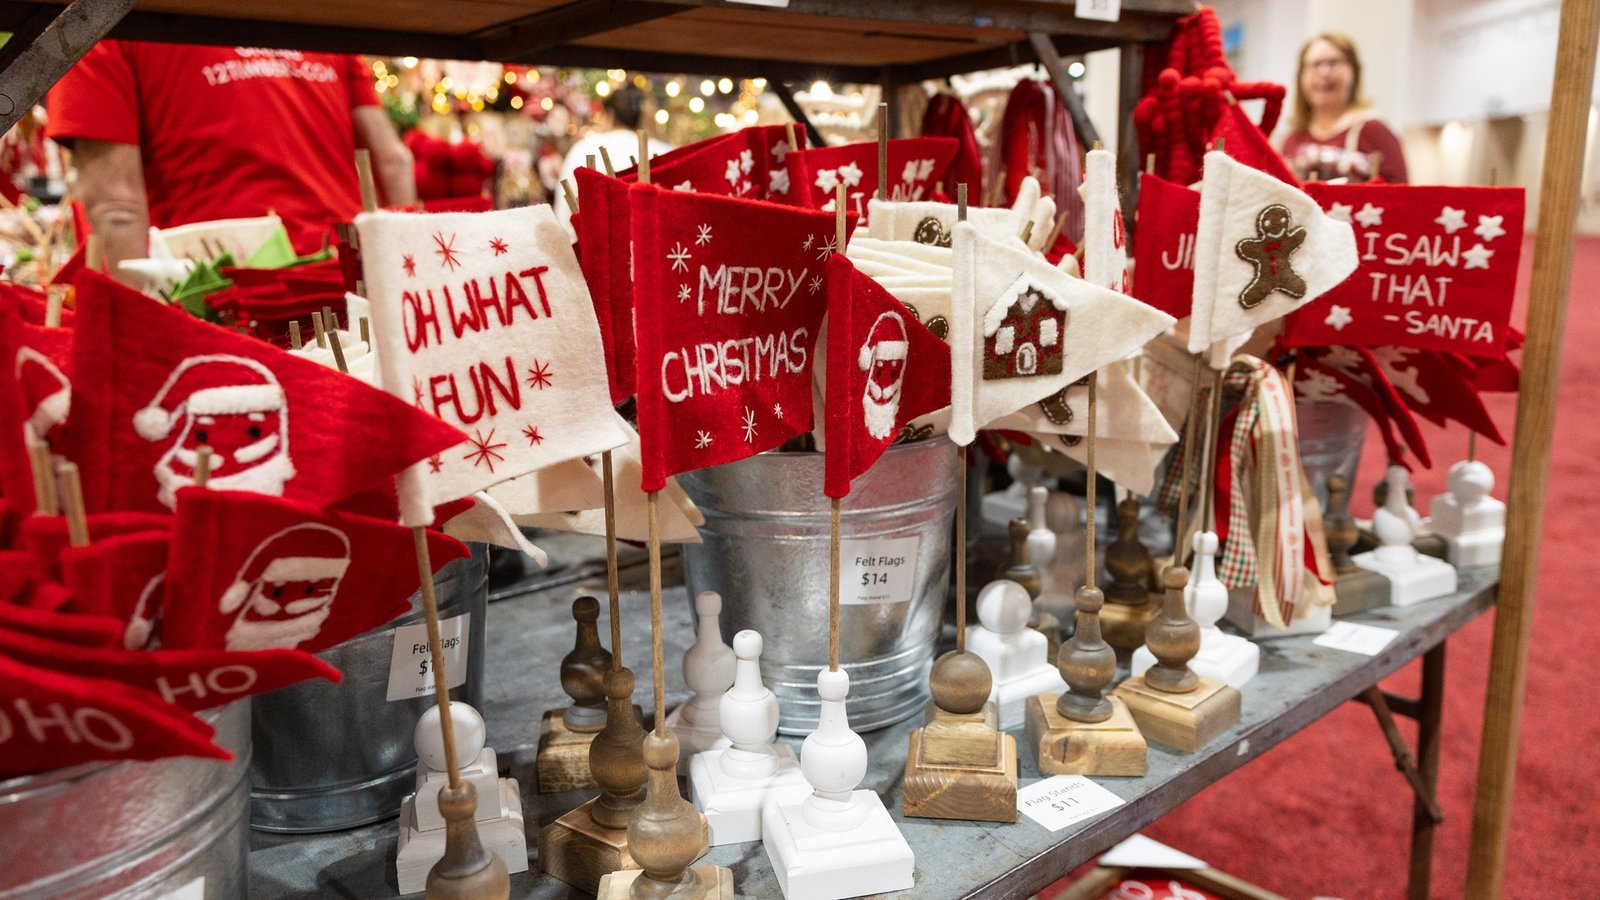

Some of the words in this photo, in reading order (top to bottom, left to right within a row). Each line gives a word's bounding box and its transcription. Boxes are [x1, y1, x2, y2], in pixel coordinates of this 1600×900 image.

[1361, 232, 1381, 261] I
[1384, 233, 1460, 267] SAW
[698, 264, 808, 316] MERRY
[1369, 272, 1453, 306] THAT
[403, 289, 442, 353] OH
[443, 266, 552, 338] WHAT
[661, 327, 808, 403] CHRISTMAS
[429, 356, 521, 424] FUN
[855, 557, 876, 567] Felt
[878, 556, 905, 567] Flags
[861, 572, 888, 586] $14
[412, 641, 432, 655] Fel
[440, 637, 460, 649] lags
[156, 664, 258, 704] HO
[1024, 795, 1051, 807] Flag
[1048, 782, 1085, 797] Stands
[1051, 797, 1080, 811] $11
